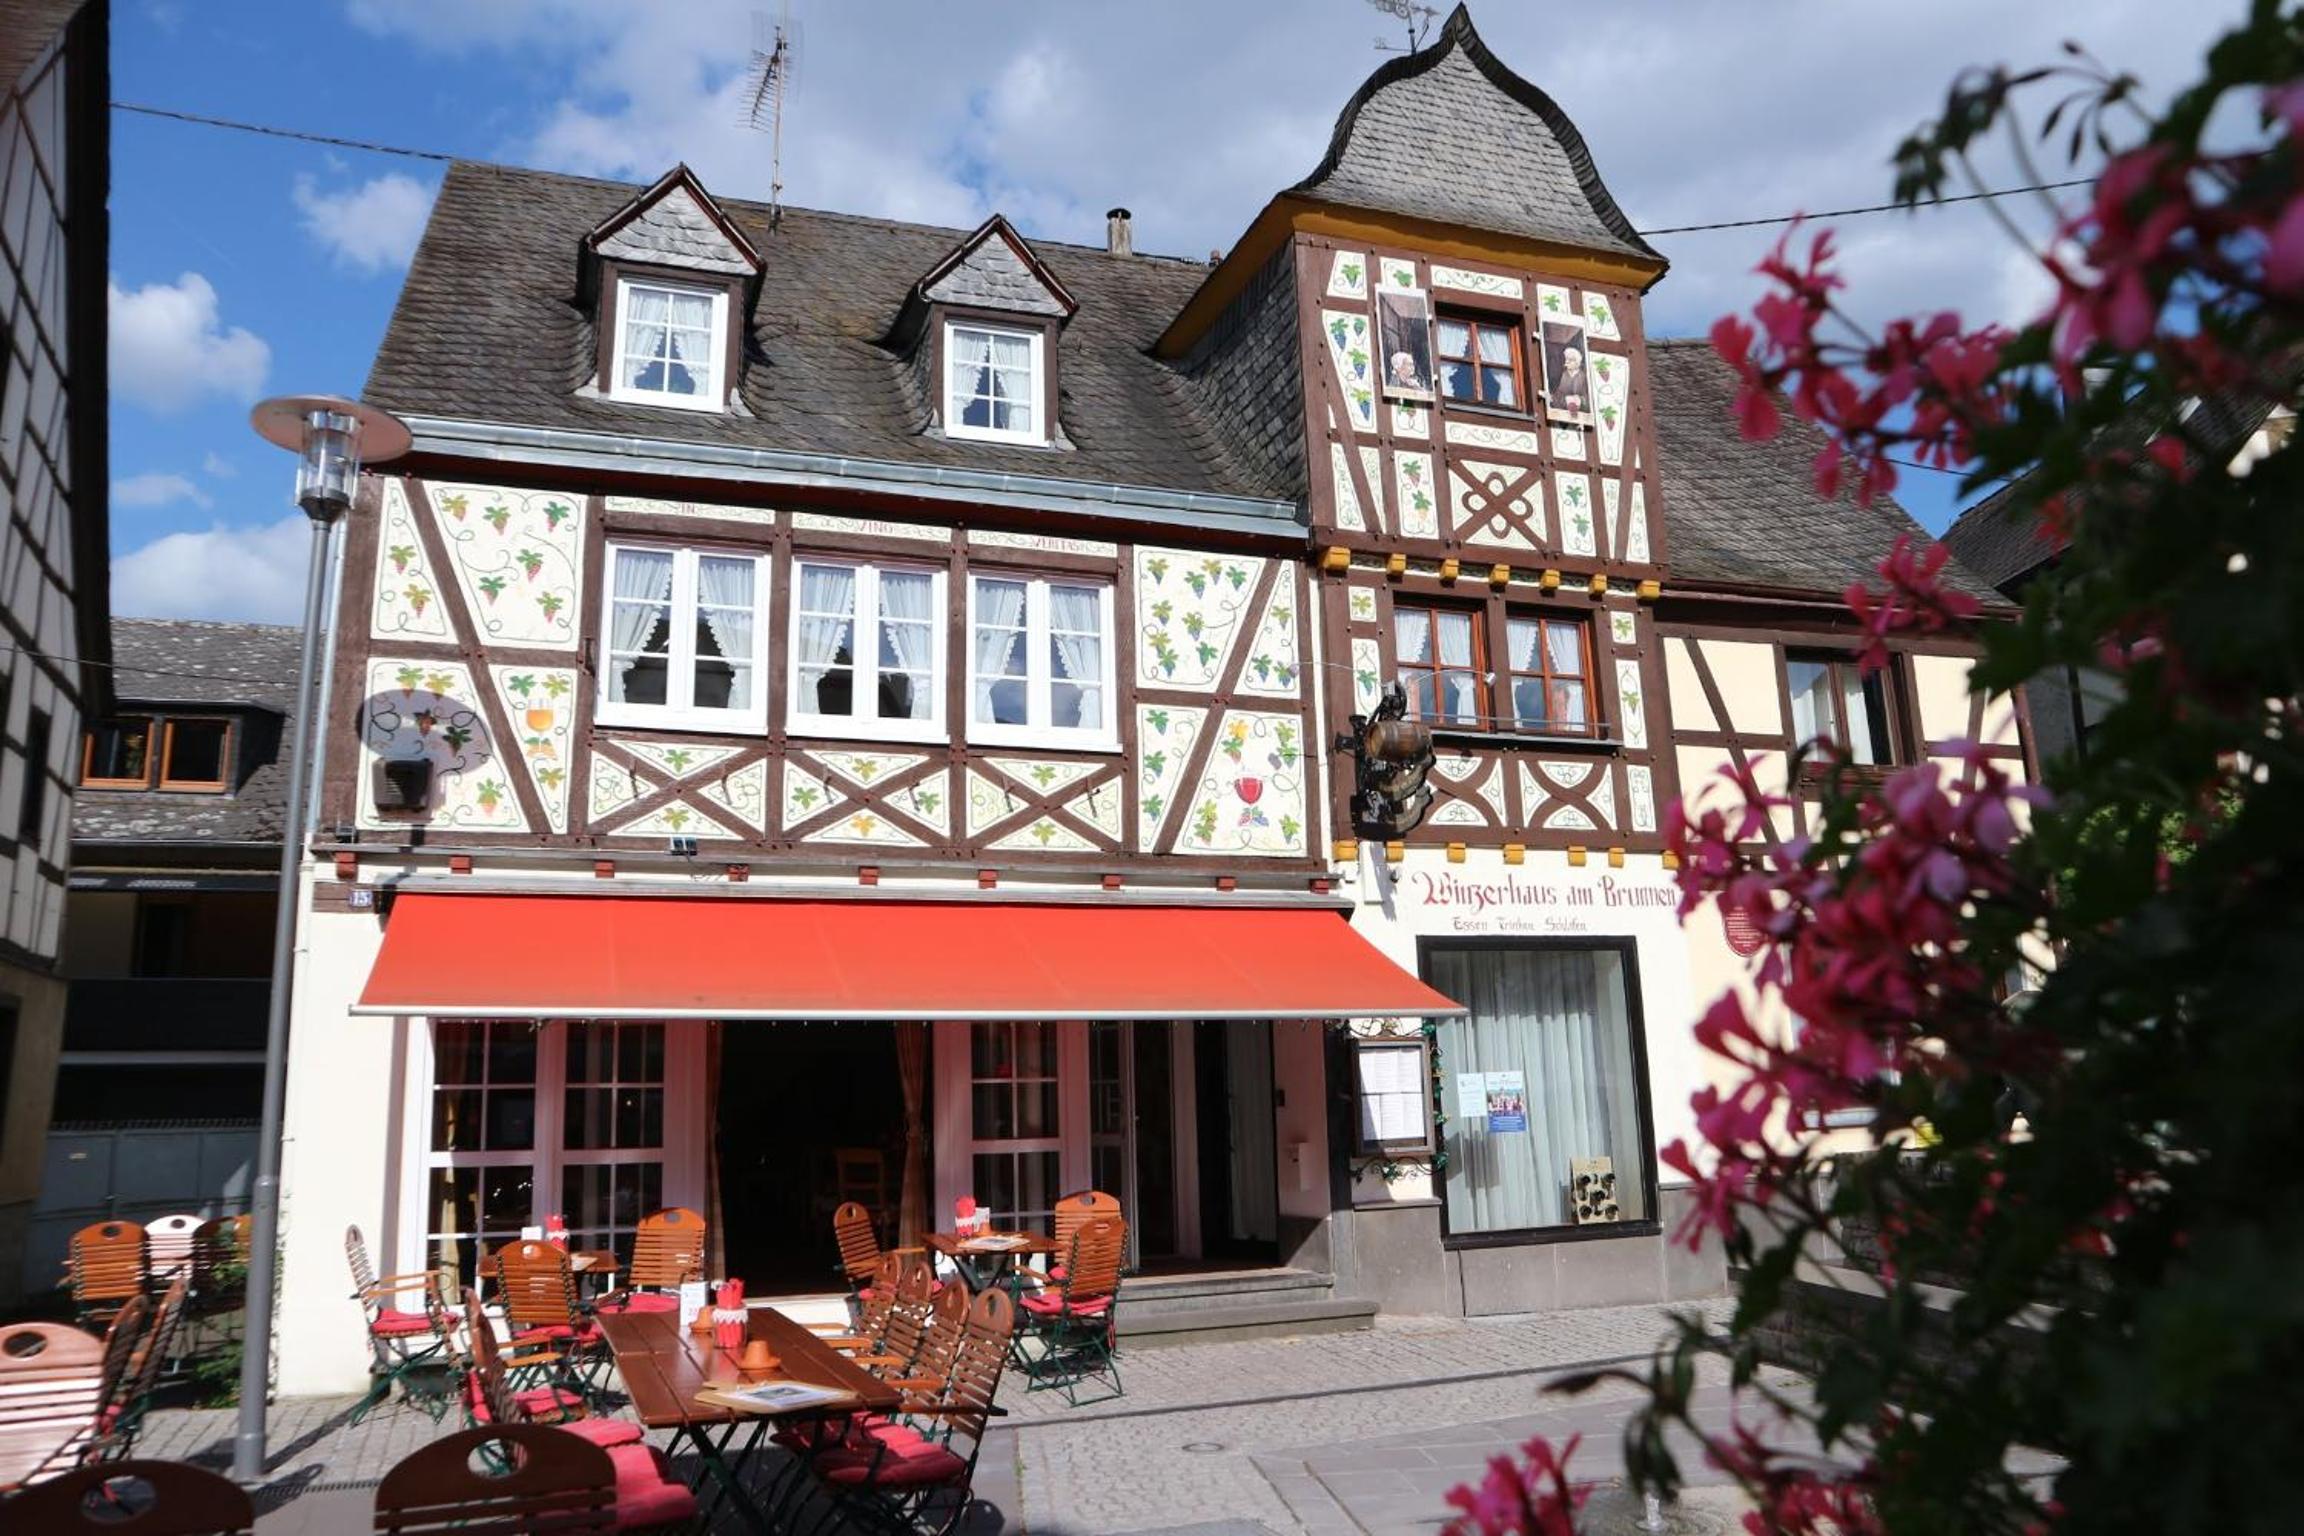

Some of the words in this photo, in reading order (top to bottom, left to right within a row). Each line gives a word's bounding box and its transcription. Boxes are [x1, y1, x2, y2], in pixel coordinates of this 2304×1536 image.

[681, 503, 695, 514] IN
[859, 519, 893, 534] VINO
[1411, 871, 1557, 915] Winzerhaus
[1567, 886, 1594, 906] am
[1597, 875, 1677, 907] Brunnen
[1452, 916, 1488, 931] Essen
